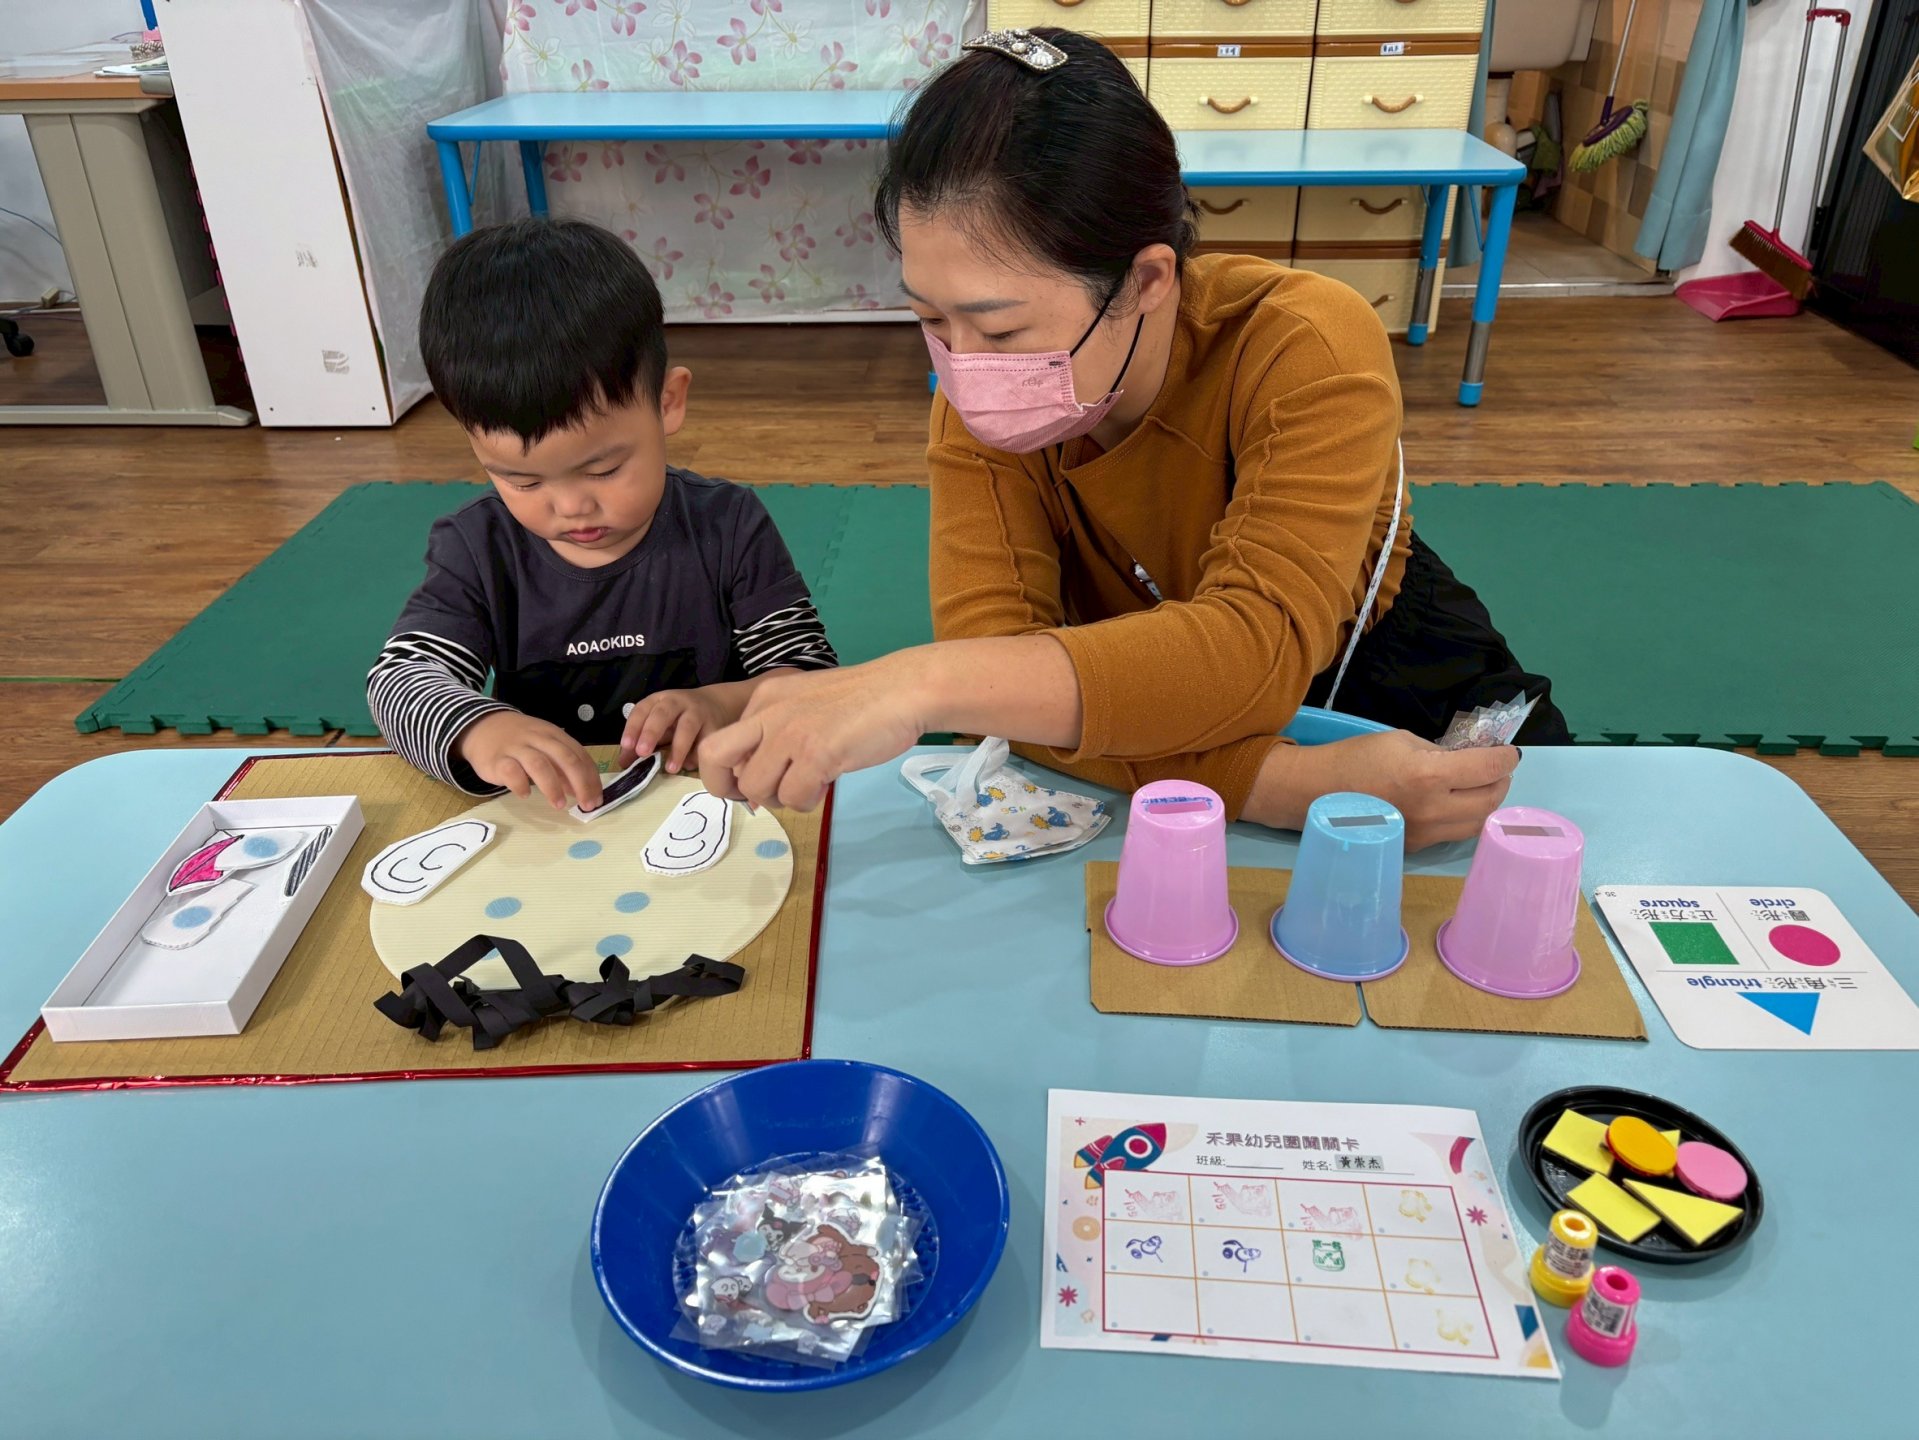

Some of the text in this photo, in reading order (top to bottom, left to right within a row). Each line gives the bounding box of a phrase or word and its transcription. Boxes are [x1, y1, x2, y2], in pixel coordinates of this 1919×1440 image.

[566, 634, 645, 656] AOAOKIDS
[1640, 898, 1701, 908] square
[1749, 898, 1796, 908] circle
[1686, 975, 1762, 989] triangle
